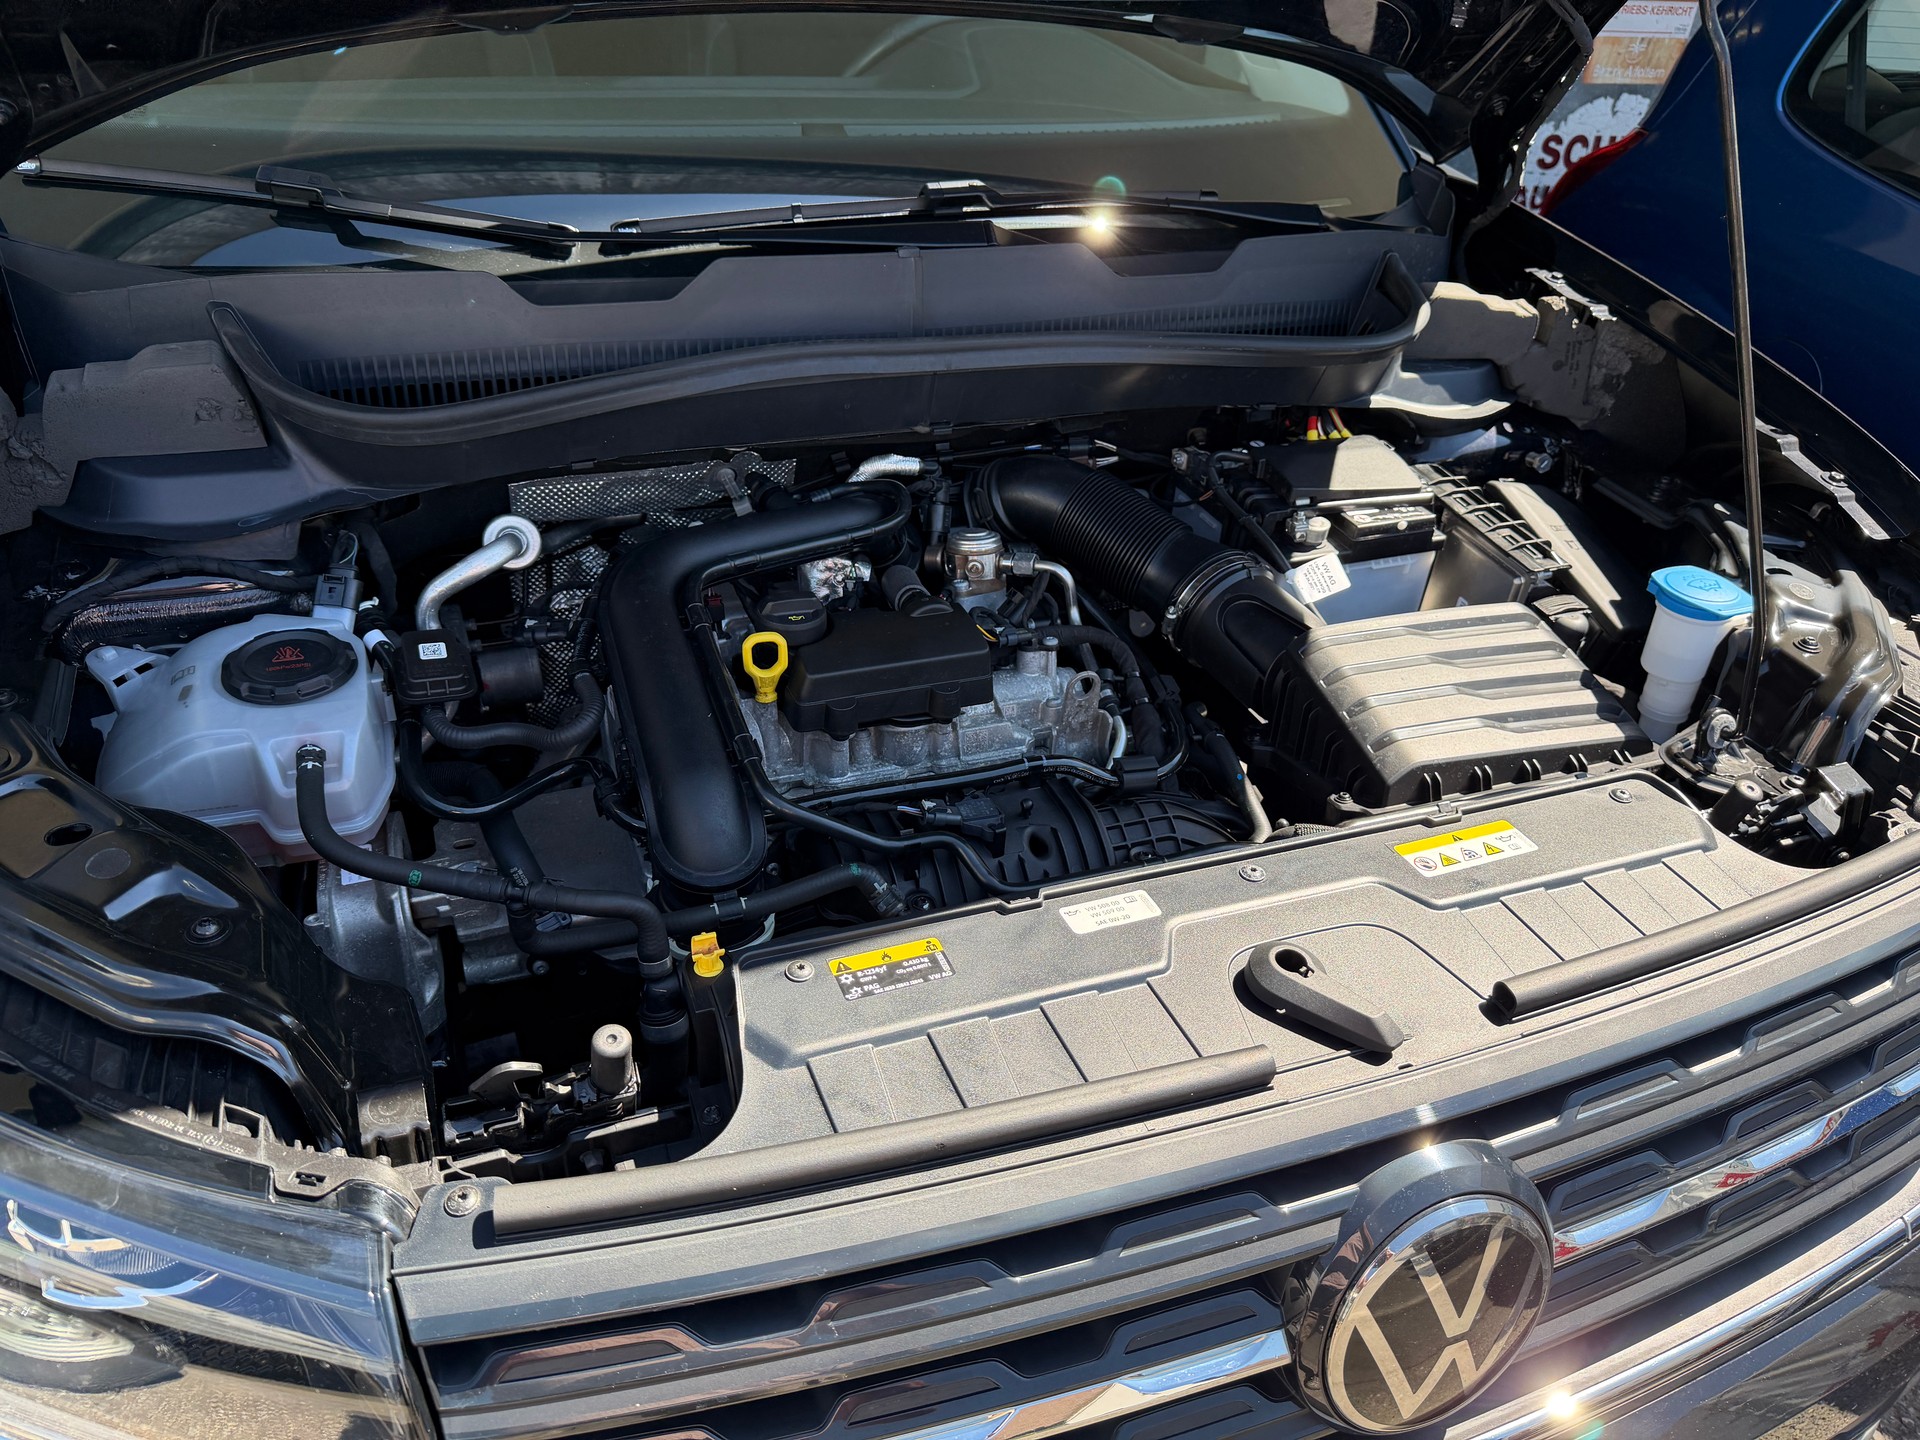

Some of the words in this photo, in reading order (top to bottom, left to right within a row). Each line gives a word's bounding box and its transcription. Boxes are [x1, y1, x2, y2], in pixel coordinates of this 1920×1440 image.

[1618, 5, 1695, 17] RIEBS-KEHRICHT
[856, 965, 888, 977] R-1234yf
[929, 973, 941, 981] VW
[941, 970, 953, 978] AG
[864, 983, 880, 992] PAG
[1332, 1200, 1549, 1429] VW
